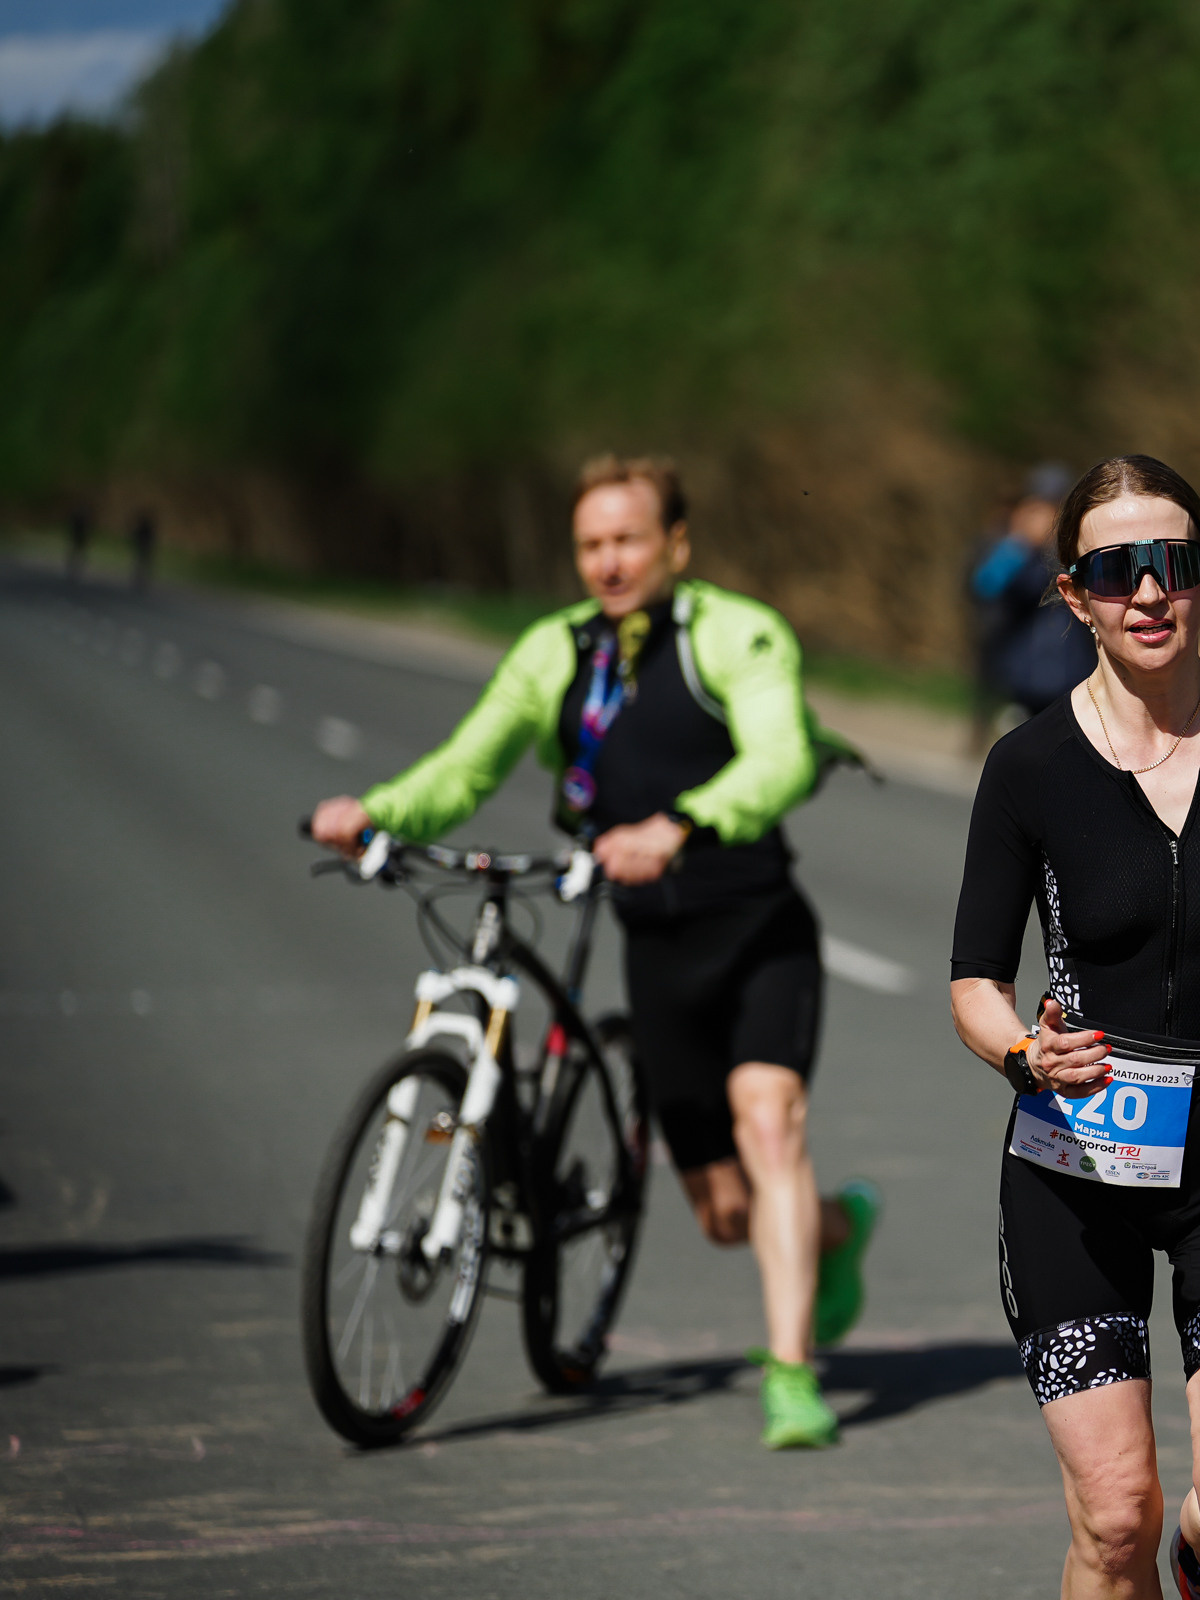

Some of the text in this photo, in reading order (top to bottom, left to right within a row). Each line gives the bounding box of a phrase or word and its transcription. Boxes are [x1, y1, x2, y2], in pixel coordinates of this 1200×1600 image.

[1107, 1068, 1180, 1084] РИАТЛОН 2023
[1074, 1121, 1110, 1139] Мария
